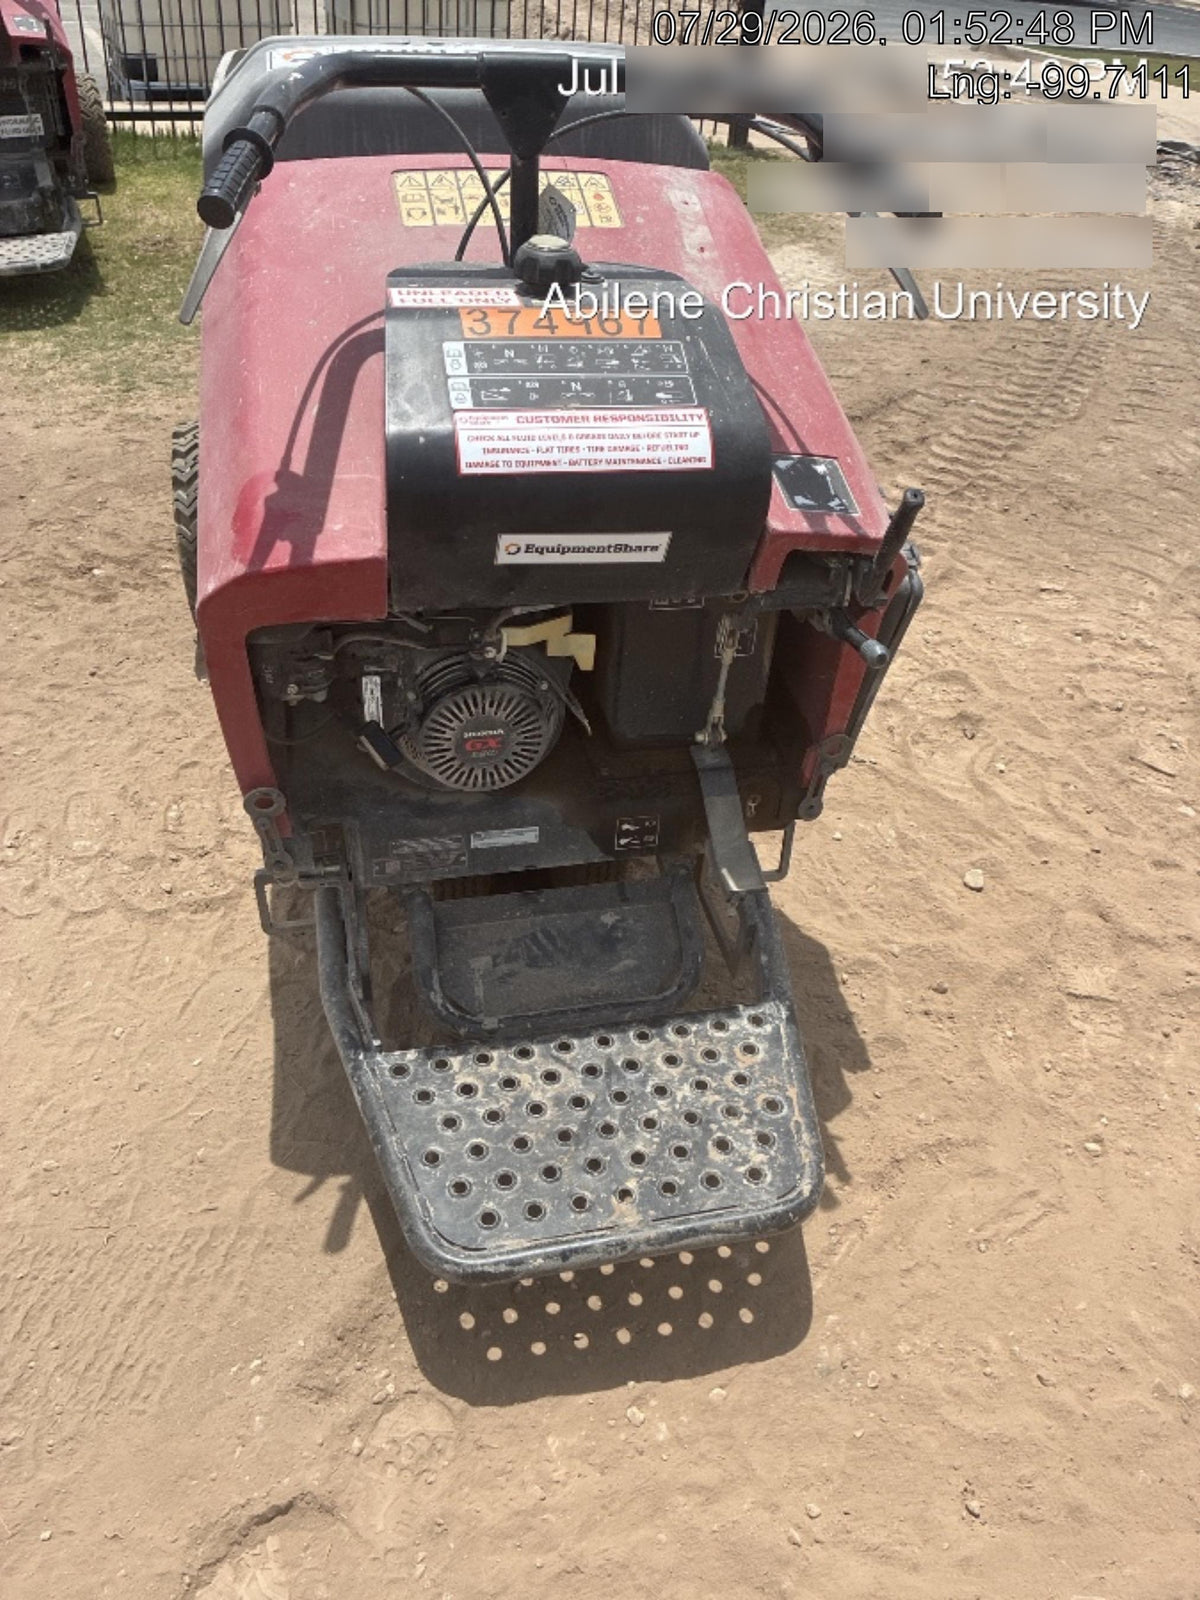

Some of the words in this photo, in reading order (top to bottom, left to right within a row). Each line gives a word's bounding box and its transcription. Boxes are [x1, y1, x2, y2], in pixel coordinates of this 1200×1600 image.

[516, 415, 591, 424] CUSTOMER
[593, 413, 703, 423] RESPONSIBILITY
[523, 542, 660, 556] EquipmentShare
